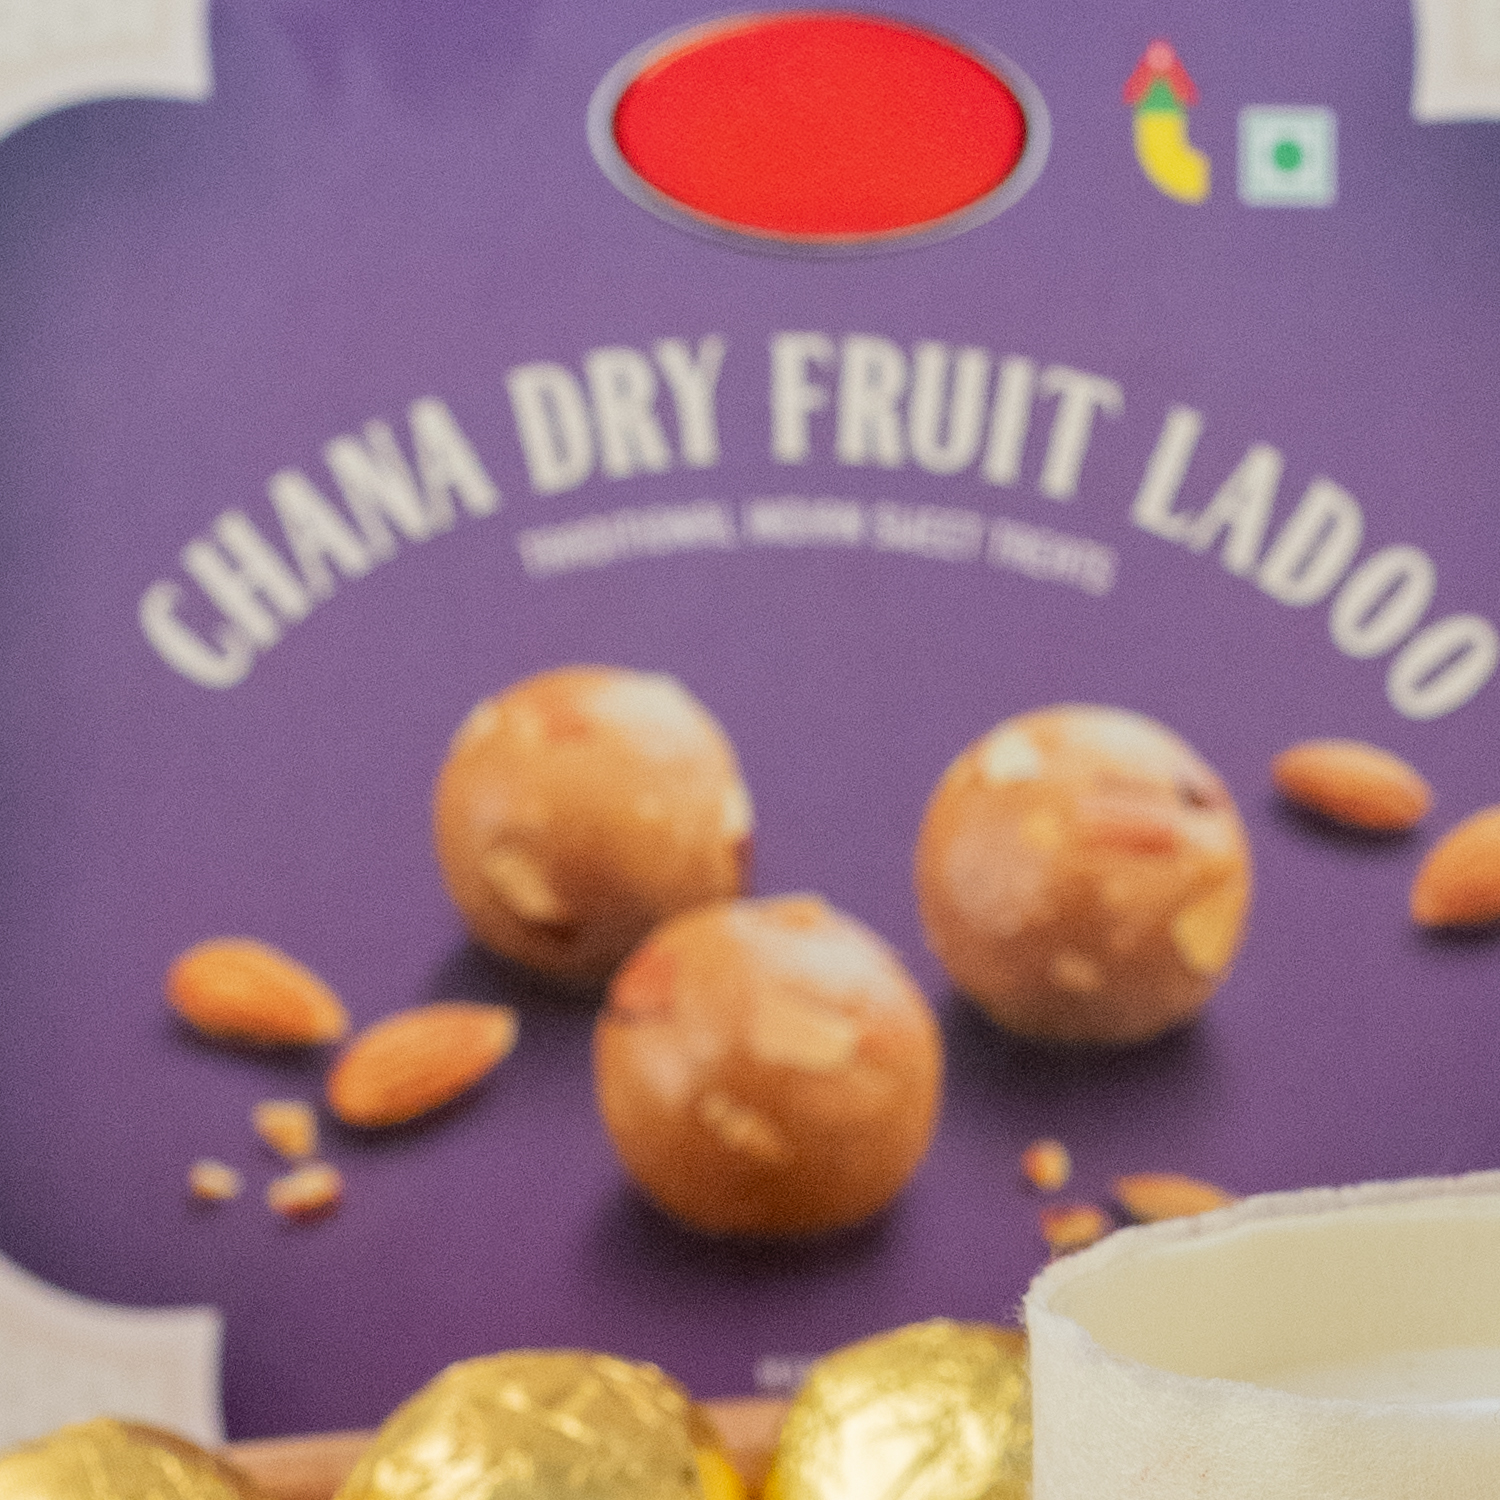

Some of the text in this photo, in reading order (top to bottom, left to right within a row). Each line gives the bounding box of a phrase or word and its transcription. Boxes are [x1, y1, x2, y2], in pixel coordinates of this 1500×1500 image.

[137, 396, 500, 689] CHANA
[506, 334, 727, 494] DRY
[770, 331, 1123, 501] FRUIT
